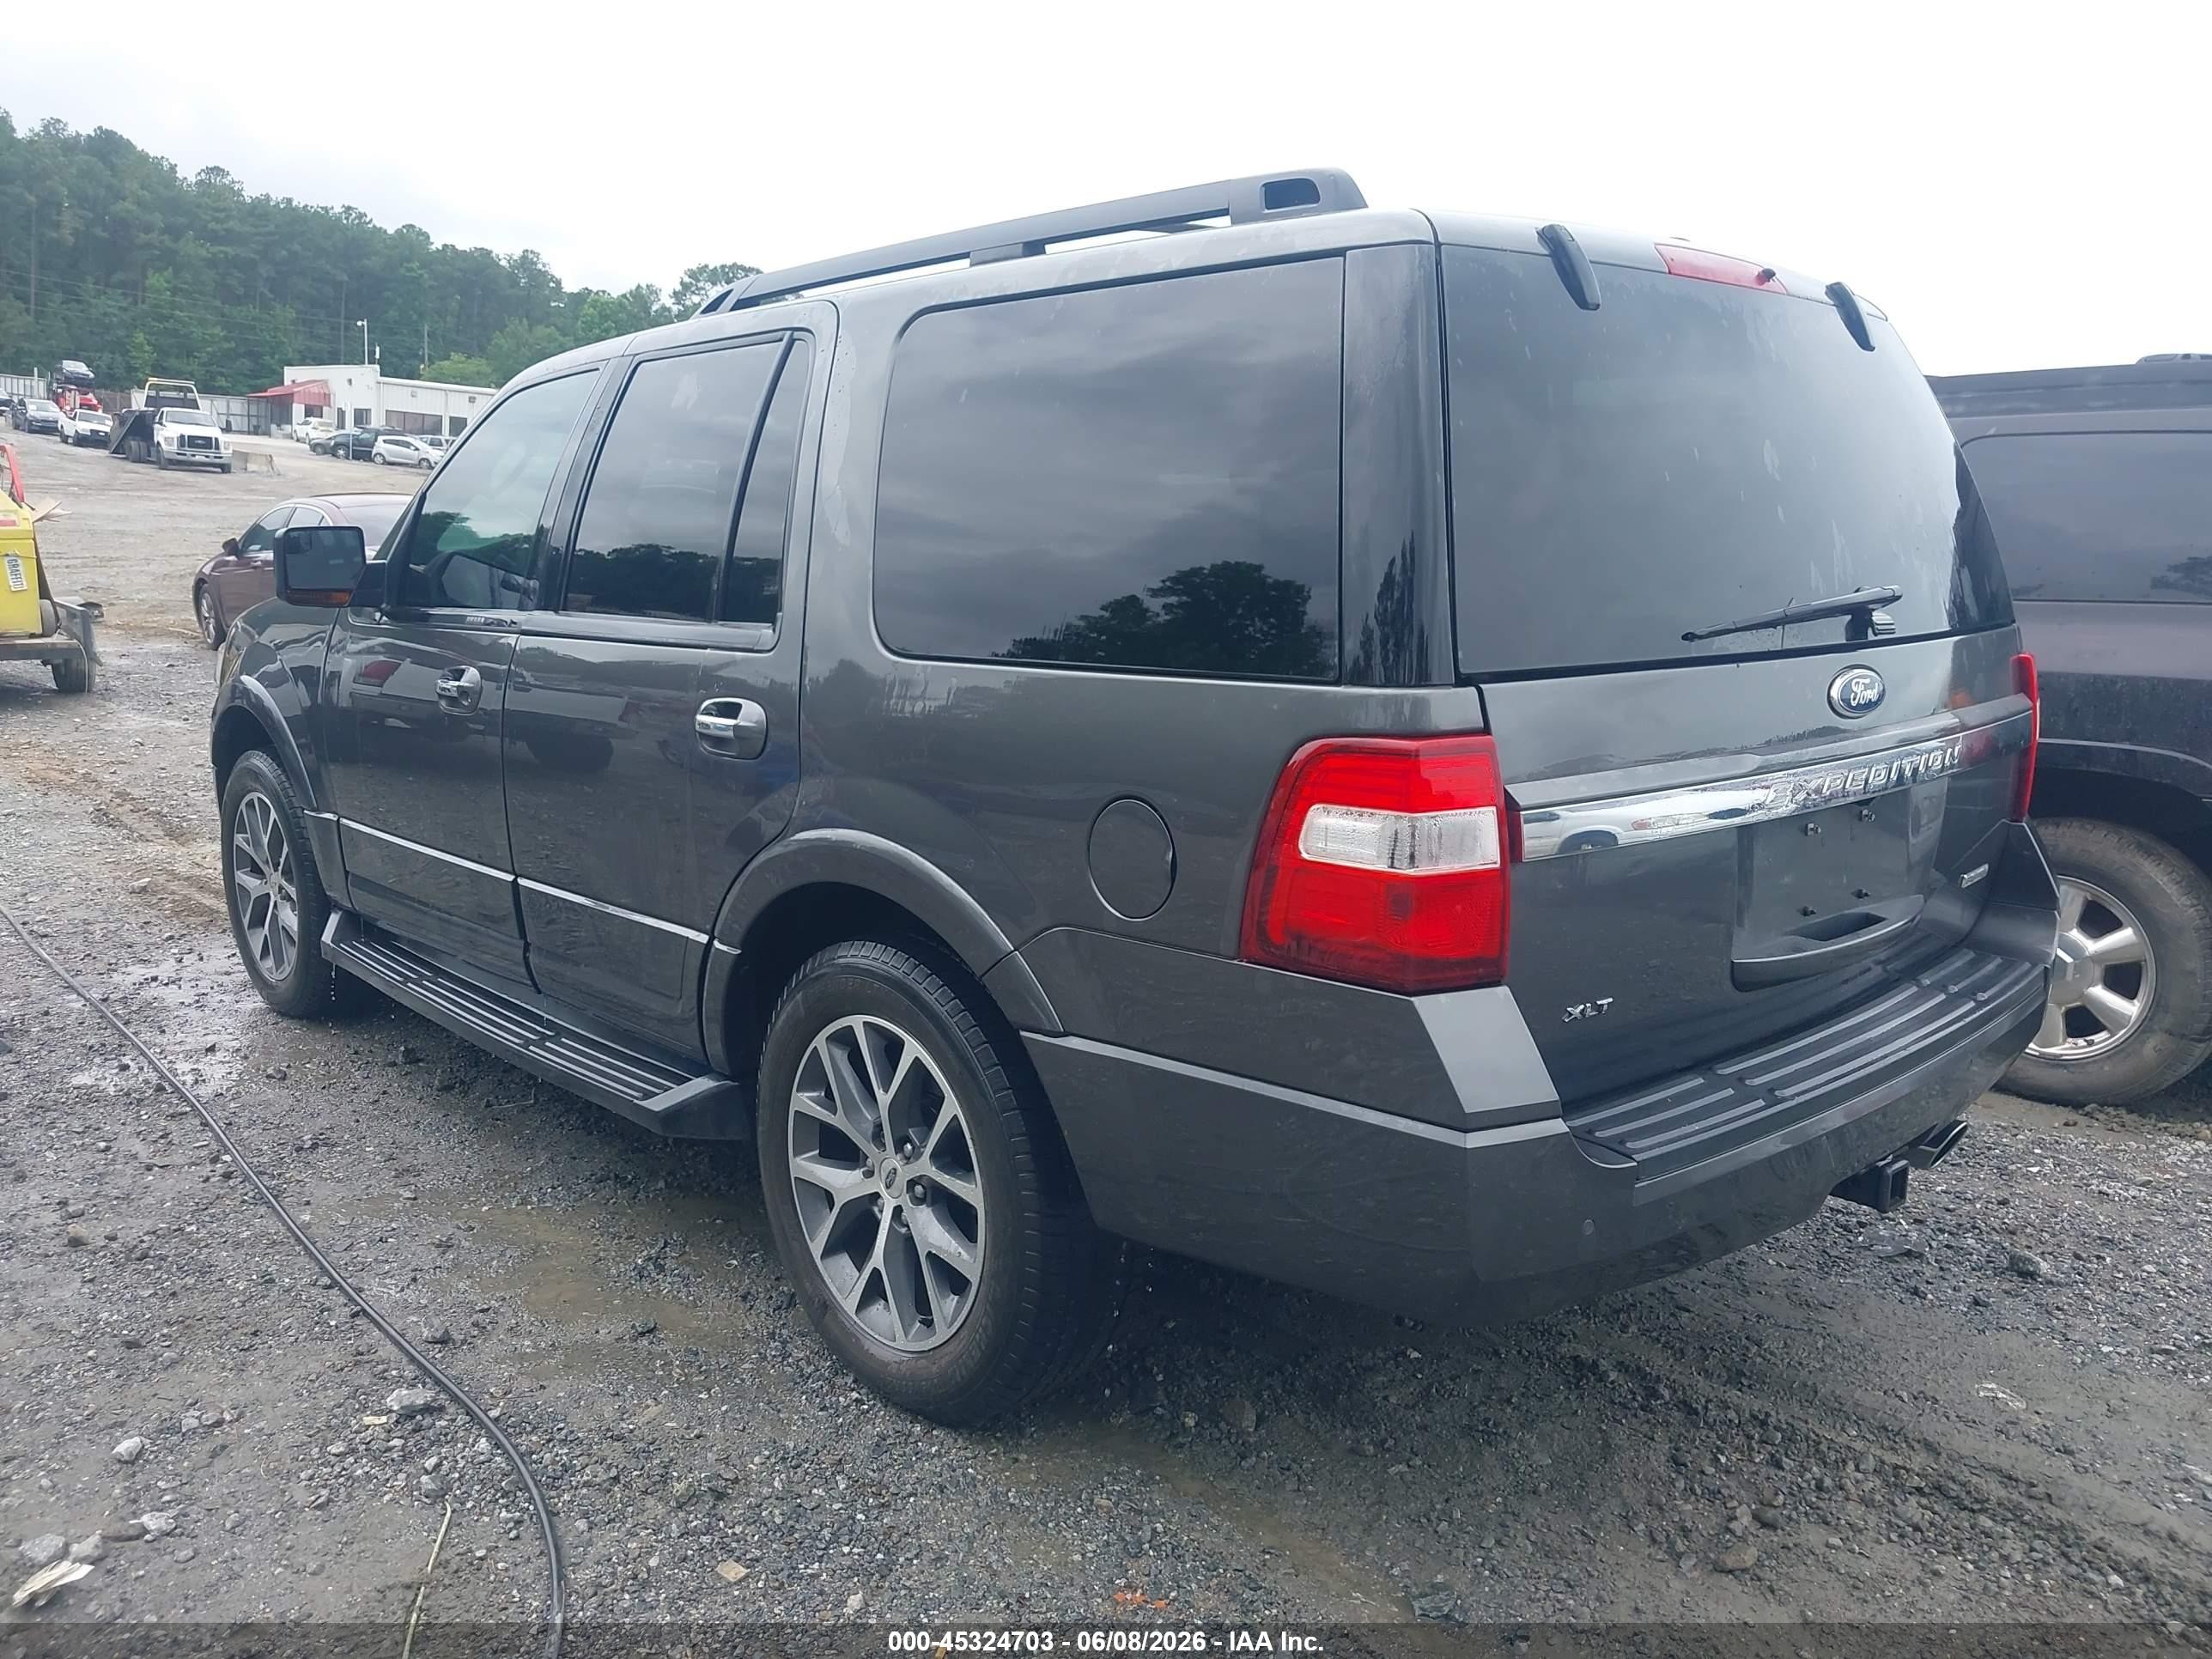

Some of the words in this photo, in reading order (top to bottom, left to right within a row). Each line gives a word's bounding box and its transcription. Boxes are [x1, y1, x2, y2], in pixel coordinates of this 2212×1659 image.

[1850, 678, 1880, 707] Ford
[1765, 744, 1962, 805] EXPEDITION
[1561, 997, 1613, 1023] XLT
